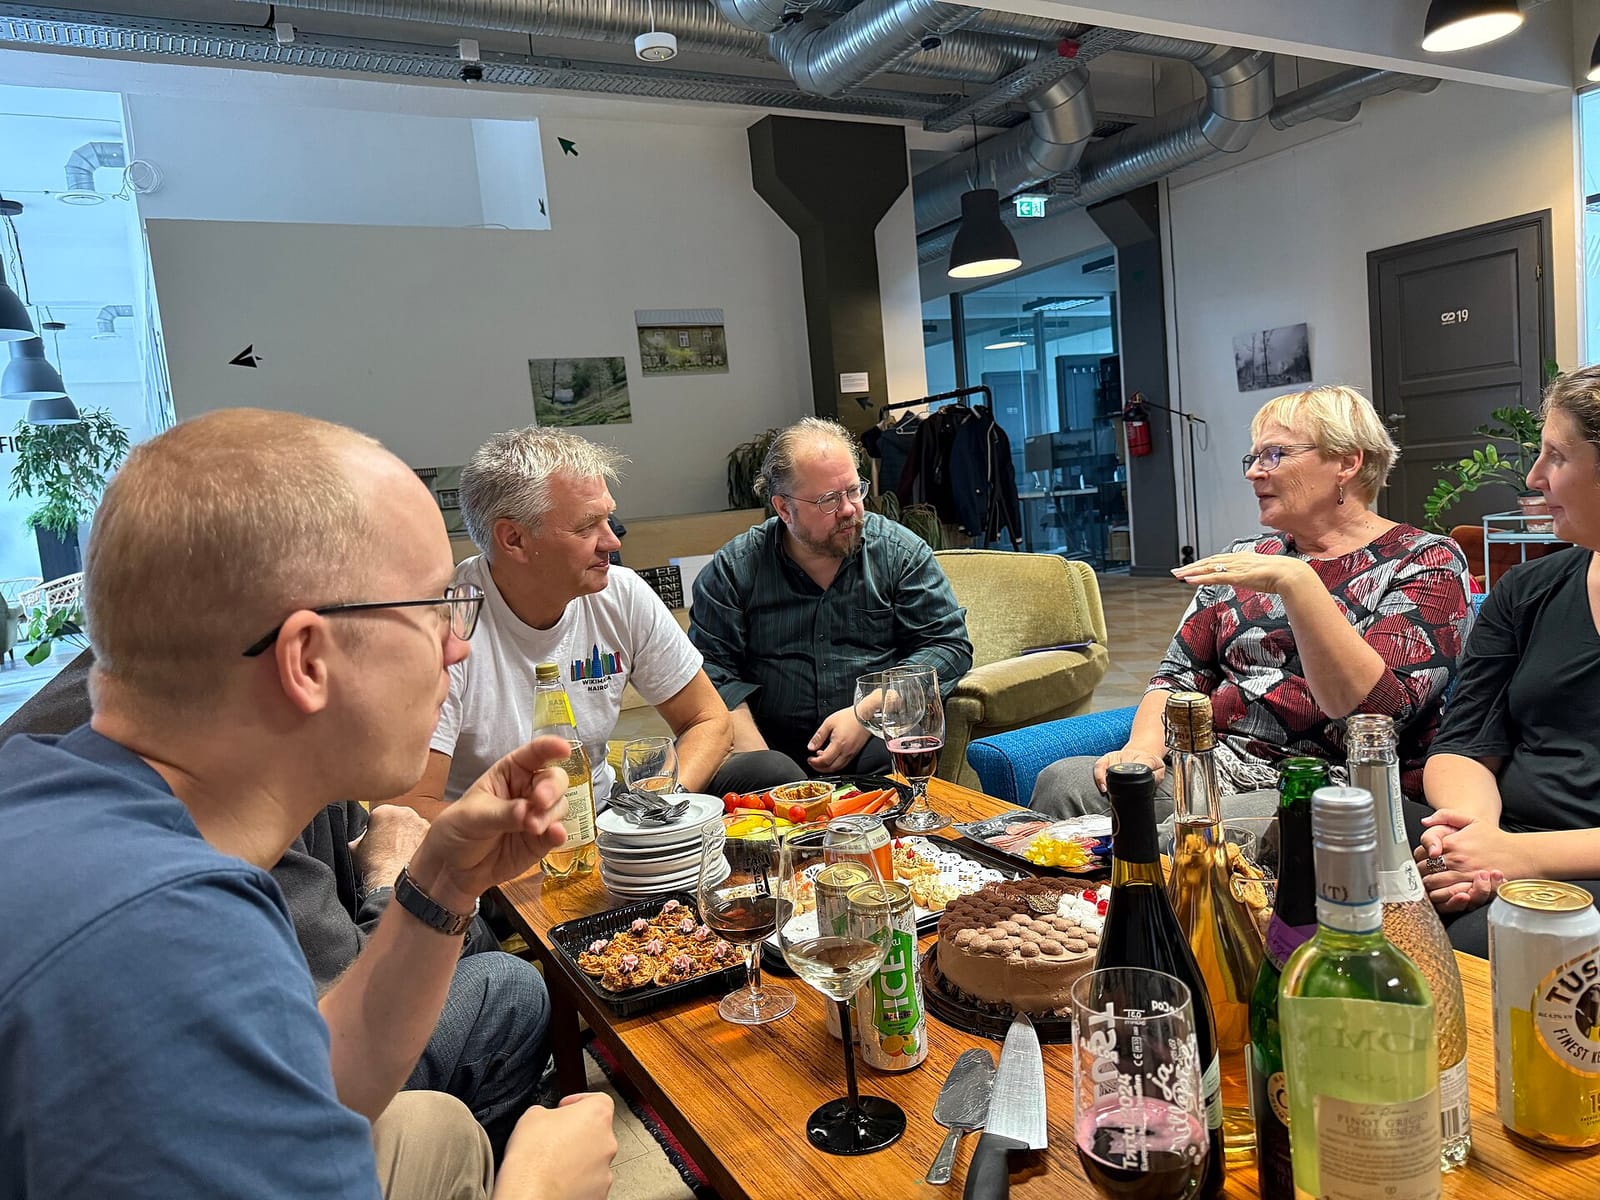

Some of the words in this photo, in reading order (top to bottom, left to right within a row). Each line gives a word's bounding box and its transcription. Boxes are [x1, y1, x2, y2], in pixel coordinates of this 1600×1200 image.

[1456, 309, 1469, 323] 19
[880, 950, 910, 1010] ICE
[1553, 1028, 1590, 1061] FINEST
[1117, 1073, 1134, 1119] 2024
[1337, 1113, 1379, 1129] PINOT
[1121, 1124, 1139, 1169] Tartu
